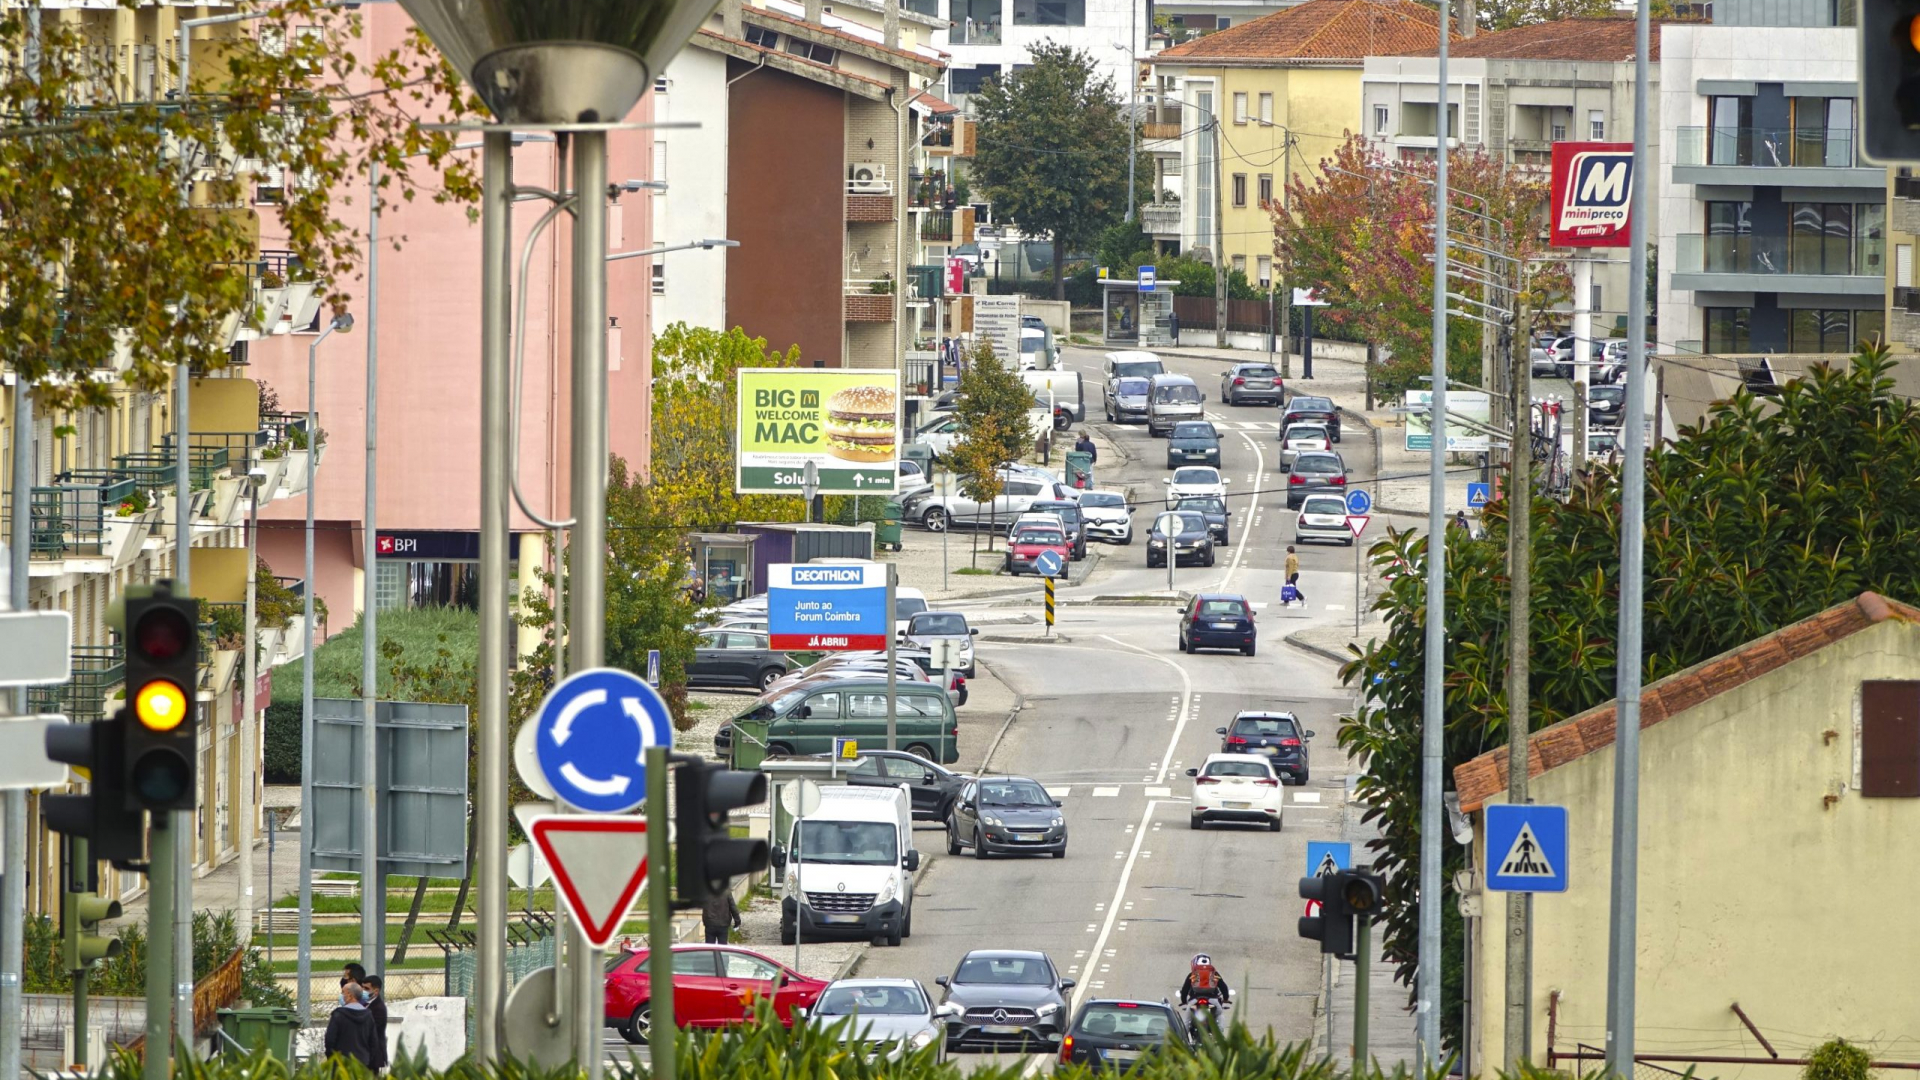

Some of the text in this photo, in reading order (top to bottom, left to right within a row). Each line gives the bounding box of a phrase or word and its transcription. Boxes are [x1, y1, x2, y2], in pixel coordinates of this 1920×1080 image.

[1565, 208, 1624, 220] minipreço
[1577, 225, 1608, 235] family
[756, 389, 795, 408] BIG
[756, 410, 819, 420] WELCOME
[754, 422, 819, 444] MAC
[774, 472, 820, 485] Solu
[394, 538, 417, 552] BPI
[795, 570, 860, 581] DECATHLON
[795, 601, 819, 610] Junto
[795, 611, 860, 621] Forum Coimbra
[808, 635, 848, 646] JÁ ABRIU
